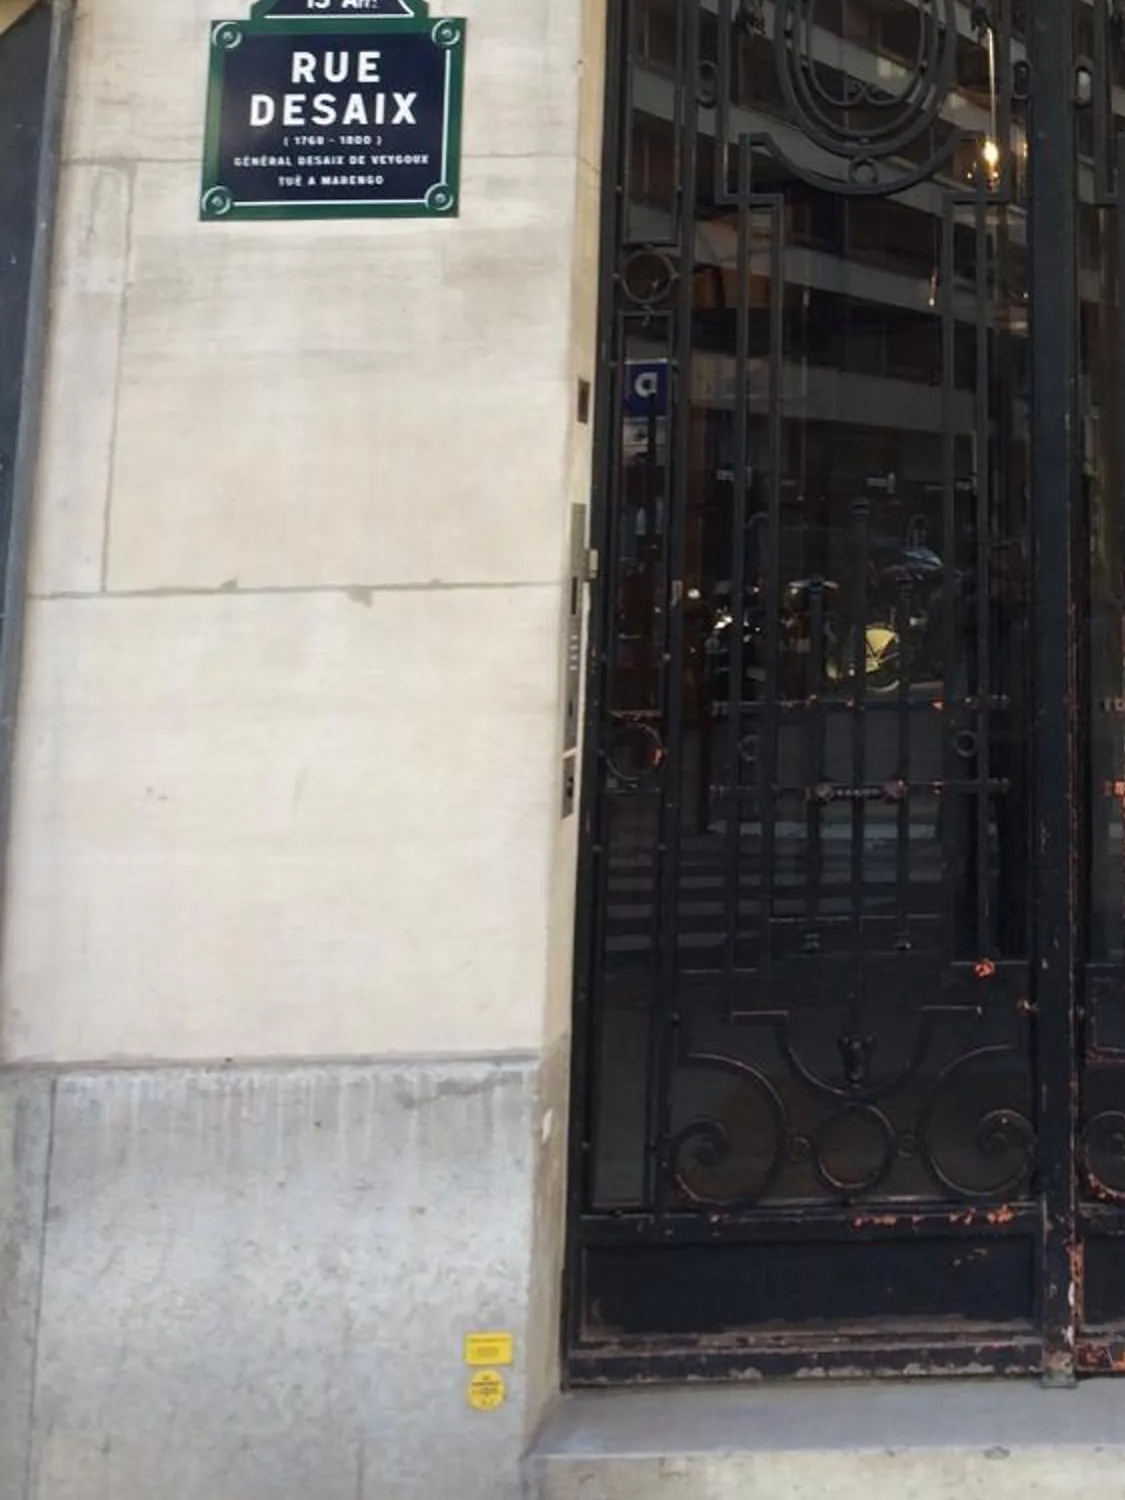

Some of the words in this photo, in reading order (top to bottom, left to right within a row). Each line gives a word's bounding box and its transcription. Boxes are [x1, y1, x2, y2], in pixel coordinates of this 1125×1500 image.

[291, 51, 381, 84] RUE
[249, 92, 418, 127] DESAIX
[233, 153, 293, 168] GÉNÉRAL
[297, 154, 344, 166] DESAIX
[349, 154, 366, 166] DE
[370, 154, 429, 166] VEYGOUX
[320, 175, 385, 186] MARENGO
